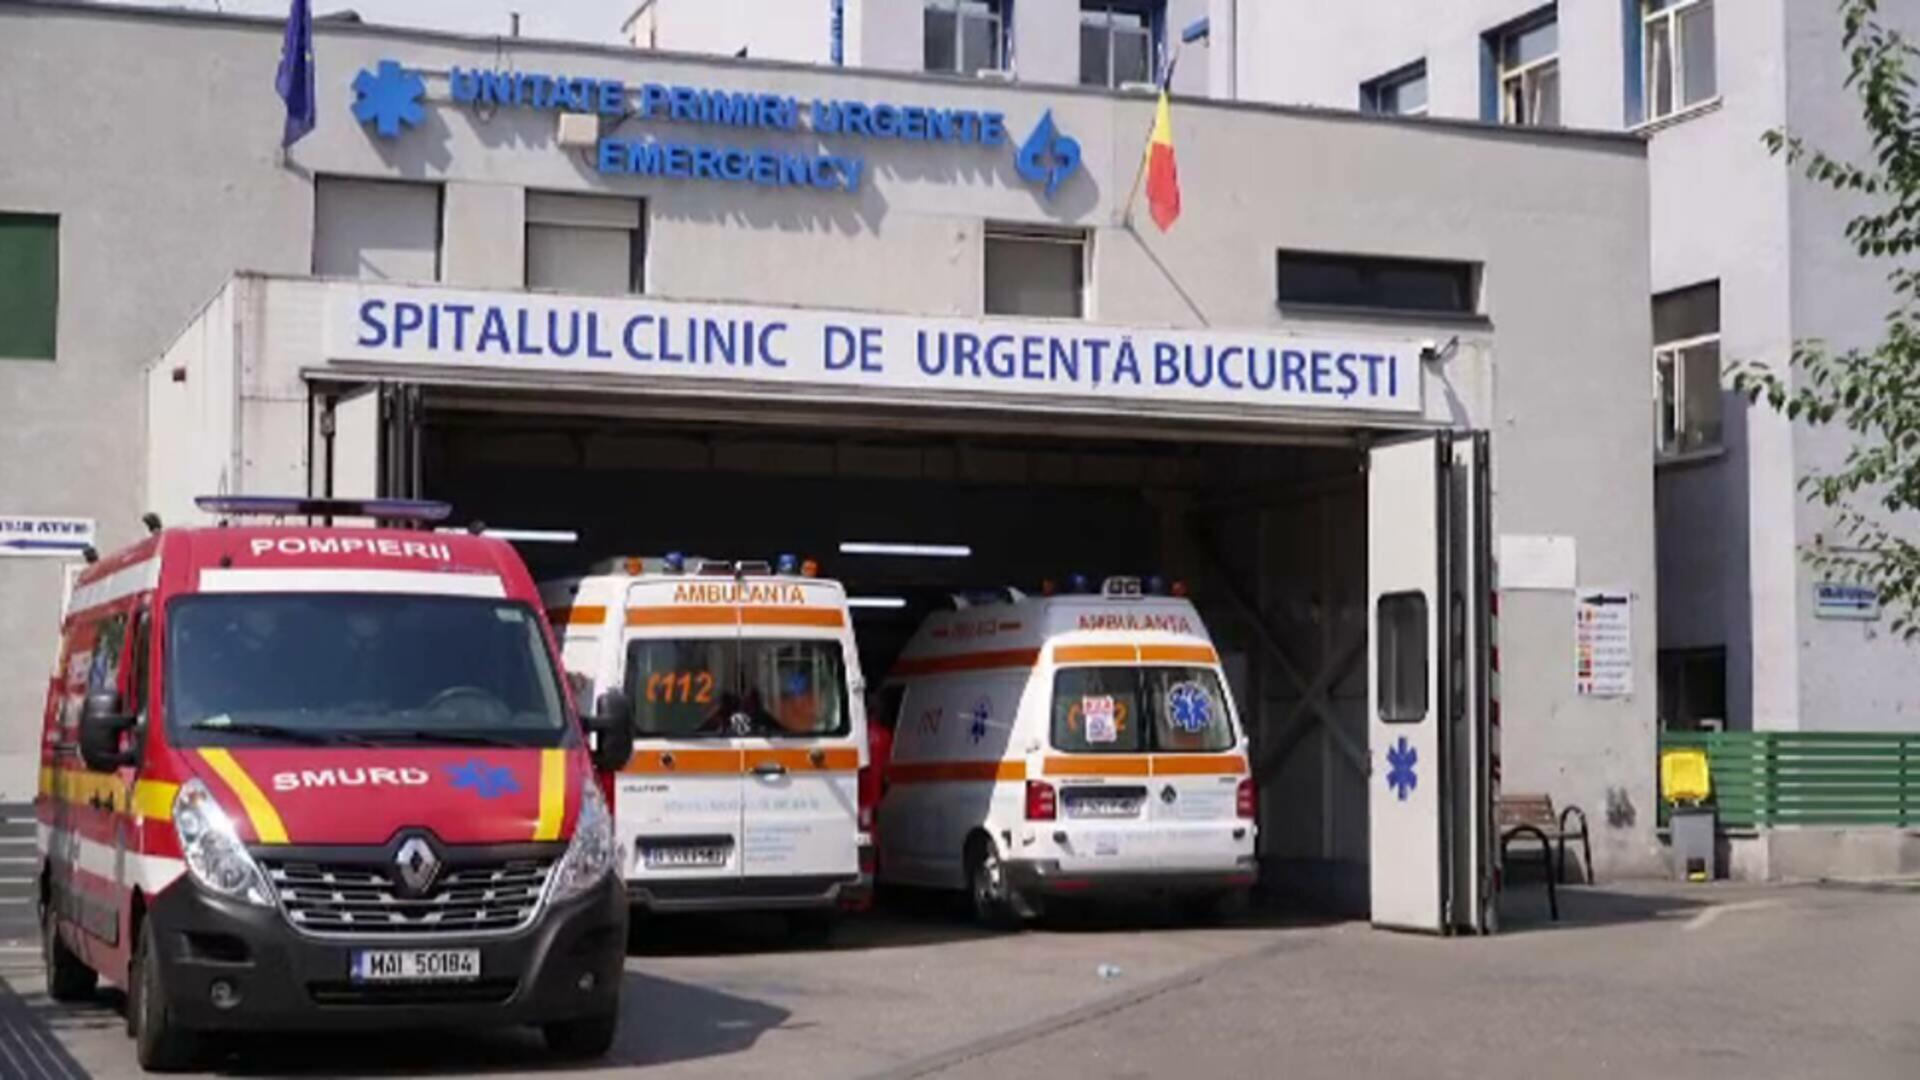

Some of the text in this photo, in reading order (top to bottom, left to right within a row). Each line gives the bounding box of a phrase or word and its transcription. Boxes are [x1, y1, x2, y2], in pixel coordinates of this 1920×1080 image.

[450, 66, 625, 115] UNITATE
[642, 87, 798, 130] PRIMIRI
[598, 138, 865, 192] EMERGENCY
[357, 299, 1399, 400] SPITALUL CLINIC DE URGENȚĂ BUCUREȘTI
[250, 537, 452, 562] POMPIERII
[272, 766, 430, 792] SMURD
[370, 953, 403, 976] MAI
